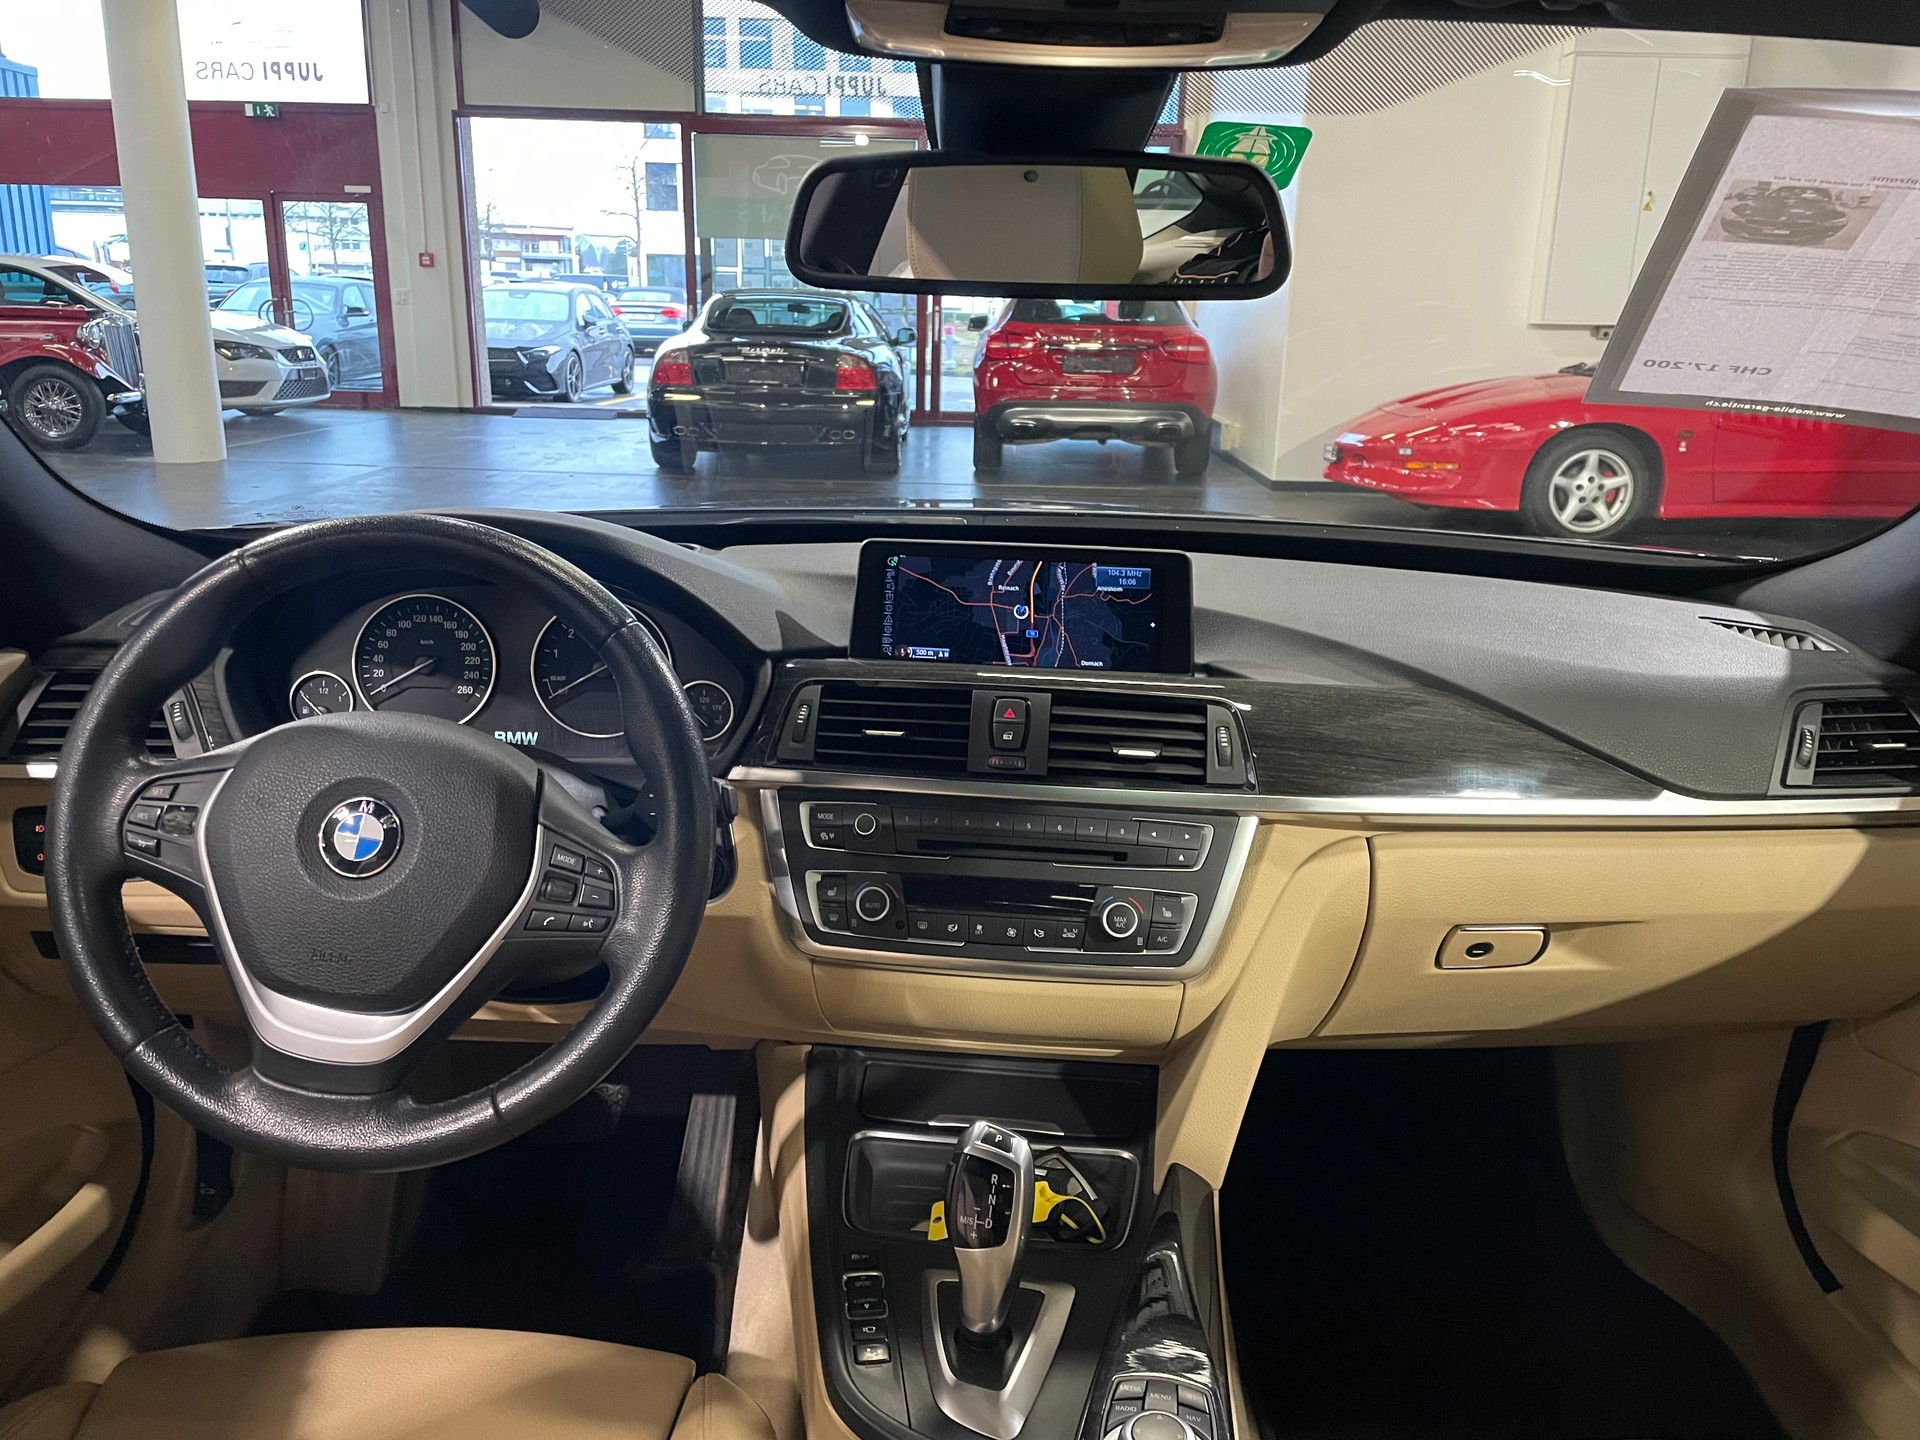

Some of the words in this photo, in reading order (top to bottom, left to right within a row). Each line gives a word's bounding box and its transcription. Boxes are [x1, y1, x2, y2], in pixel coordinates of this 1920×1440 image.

[1127, 570, 1143, 578] MHz
[1119, 578, 1137, 586] 16:06
[998, 584, 1020, 592] Reinach
[413, 615, 427, 623] 120
[429, 615, 443, 623] 140
[398, 620, 412, 629] 100
[443, 621, 458, 629] 160
[386, 629, 397, 637] 80
[455, 631, 469, 639] 180
[567, 629, 575, 639] 2
[377, 641, 389, 649] 60
[460, 643, 477, 651] 200
[553, 648, 559, 659] 1
[916, 648, 927, 656] 500
[372, 655, 384, 663] 40
[464, 657, 481, 665] 220
[372, 669, 385, 678] 20
[463, 671, 480, 680] 240
[456, 686, 474, 695] 260
[494, 731, 539, 746] BMW
[817, 812, 835, 820] MODE
[556, 853, 577, 866] MODE
[1113, 916, 1128, 924] MAX
[991, 1174, 998, 1185] R
[988, 1194, 997, 1205] N
[960, 1215, 974, 1225] M/S
[984, 1219, 993, 1229] D
[1120, 1384, 1142, 1393] MEDIA
[1150, 1392, 1172, 1401] MENU
[1186, 1414, 1201, 1423] NAV
